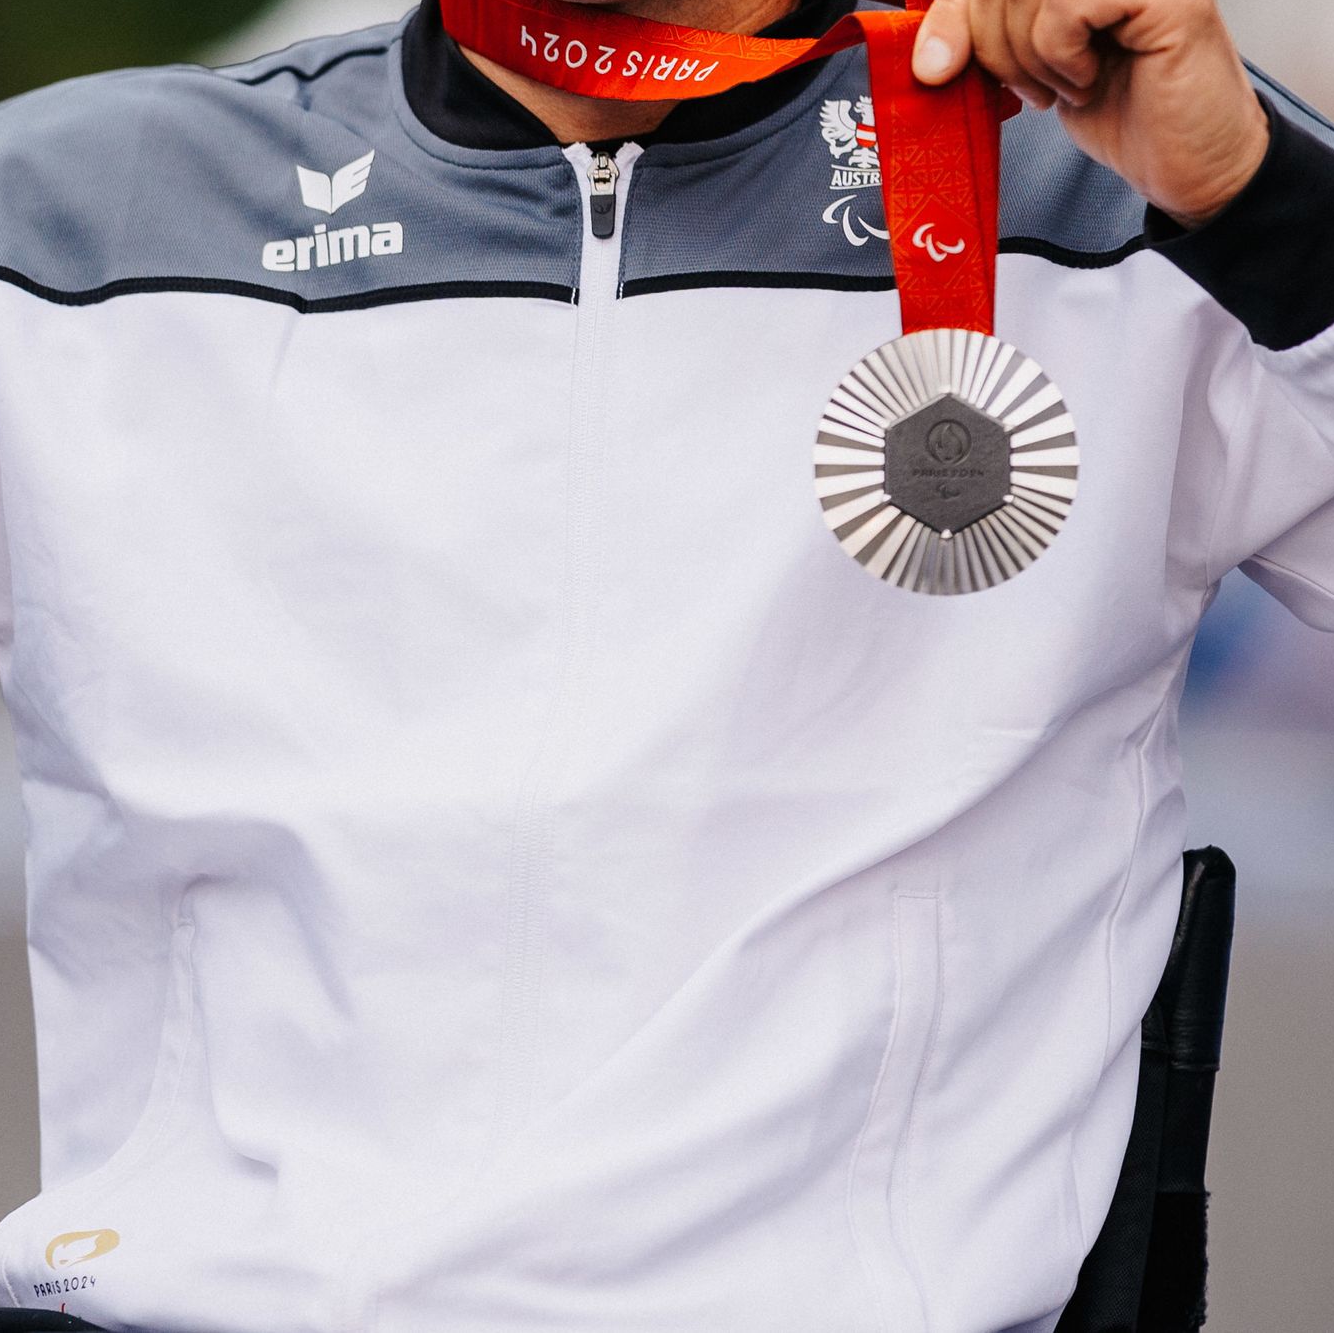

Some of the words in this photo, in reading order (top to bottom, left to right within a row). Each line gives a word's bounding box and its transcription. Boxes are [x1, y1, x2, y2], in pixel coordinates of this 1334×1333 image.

[520, 25, 616, 74] 2024
[831, 169, 882, 186] AUSTR
[262, 221, 403, 272] erima
[63, 1275, 96, 1292] 2024
